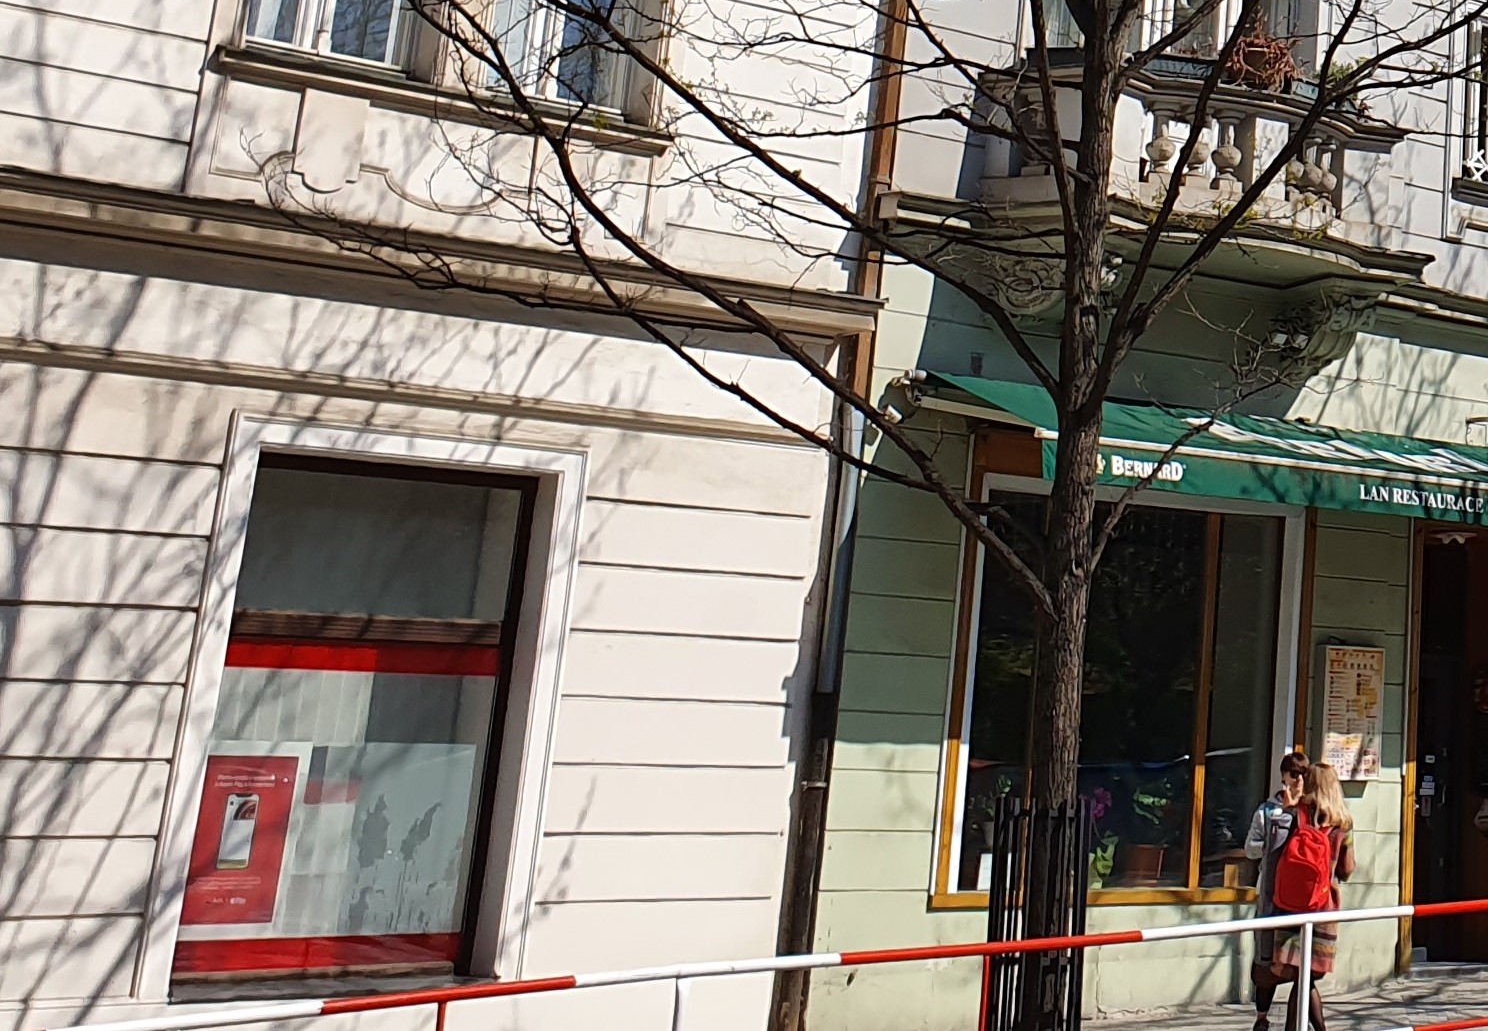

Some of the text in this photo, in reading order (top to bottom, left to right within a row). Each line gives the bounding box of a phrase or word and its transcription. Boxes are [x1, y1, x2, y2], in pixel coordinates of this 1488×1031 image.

[1111, 454, 1184, 482] BERNARD
[1359, 483, 1484, 514] LAN RESTAURACE
